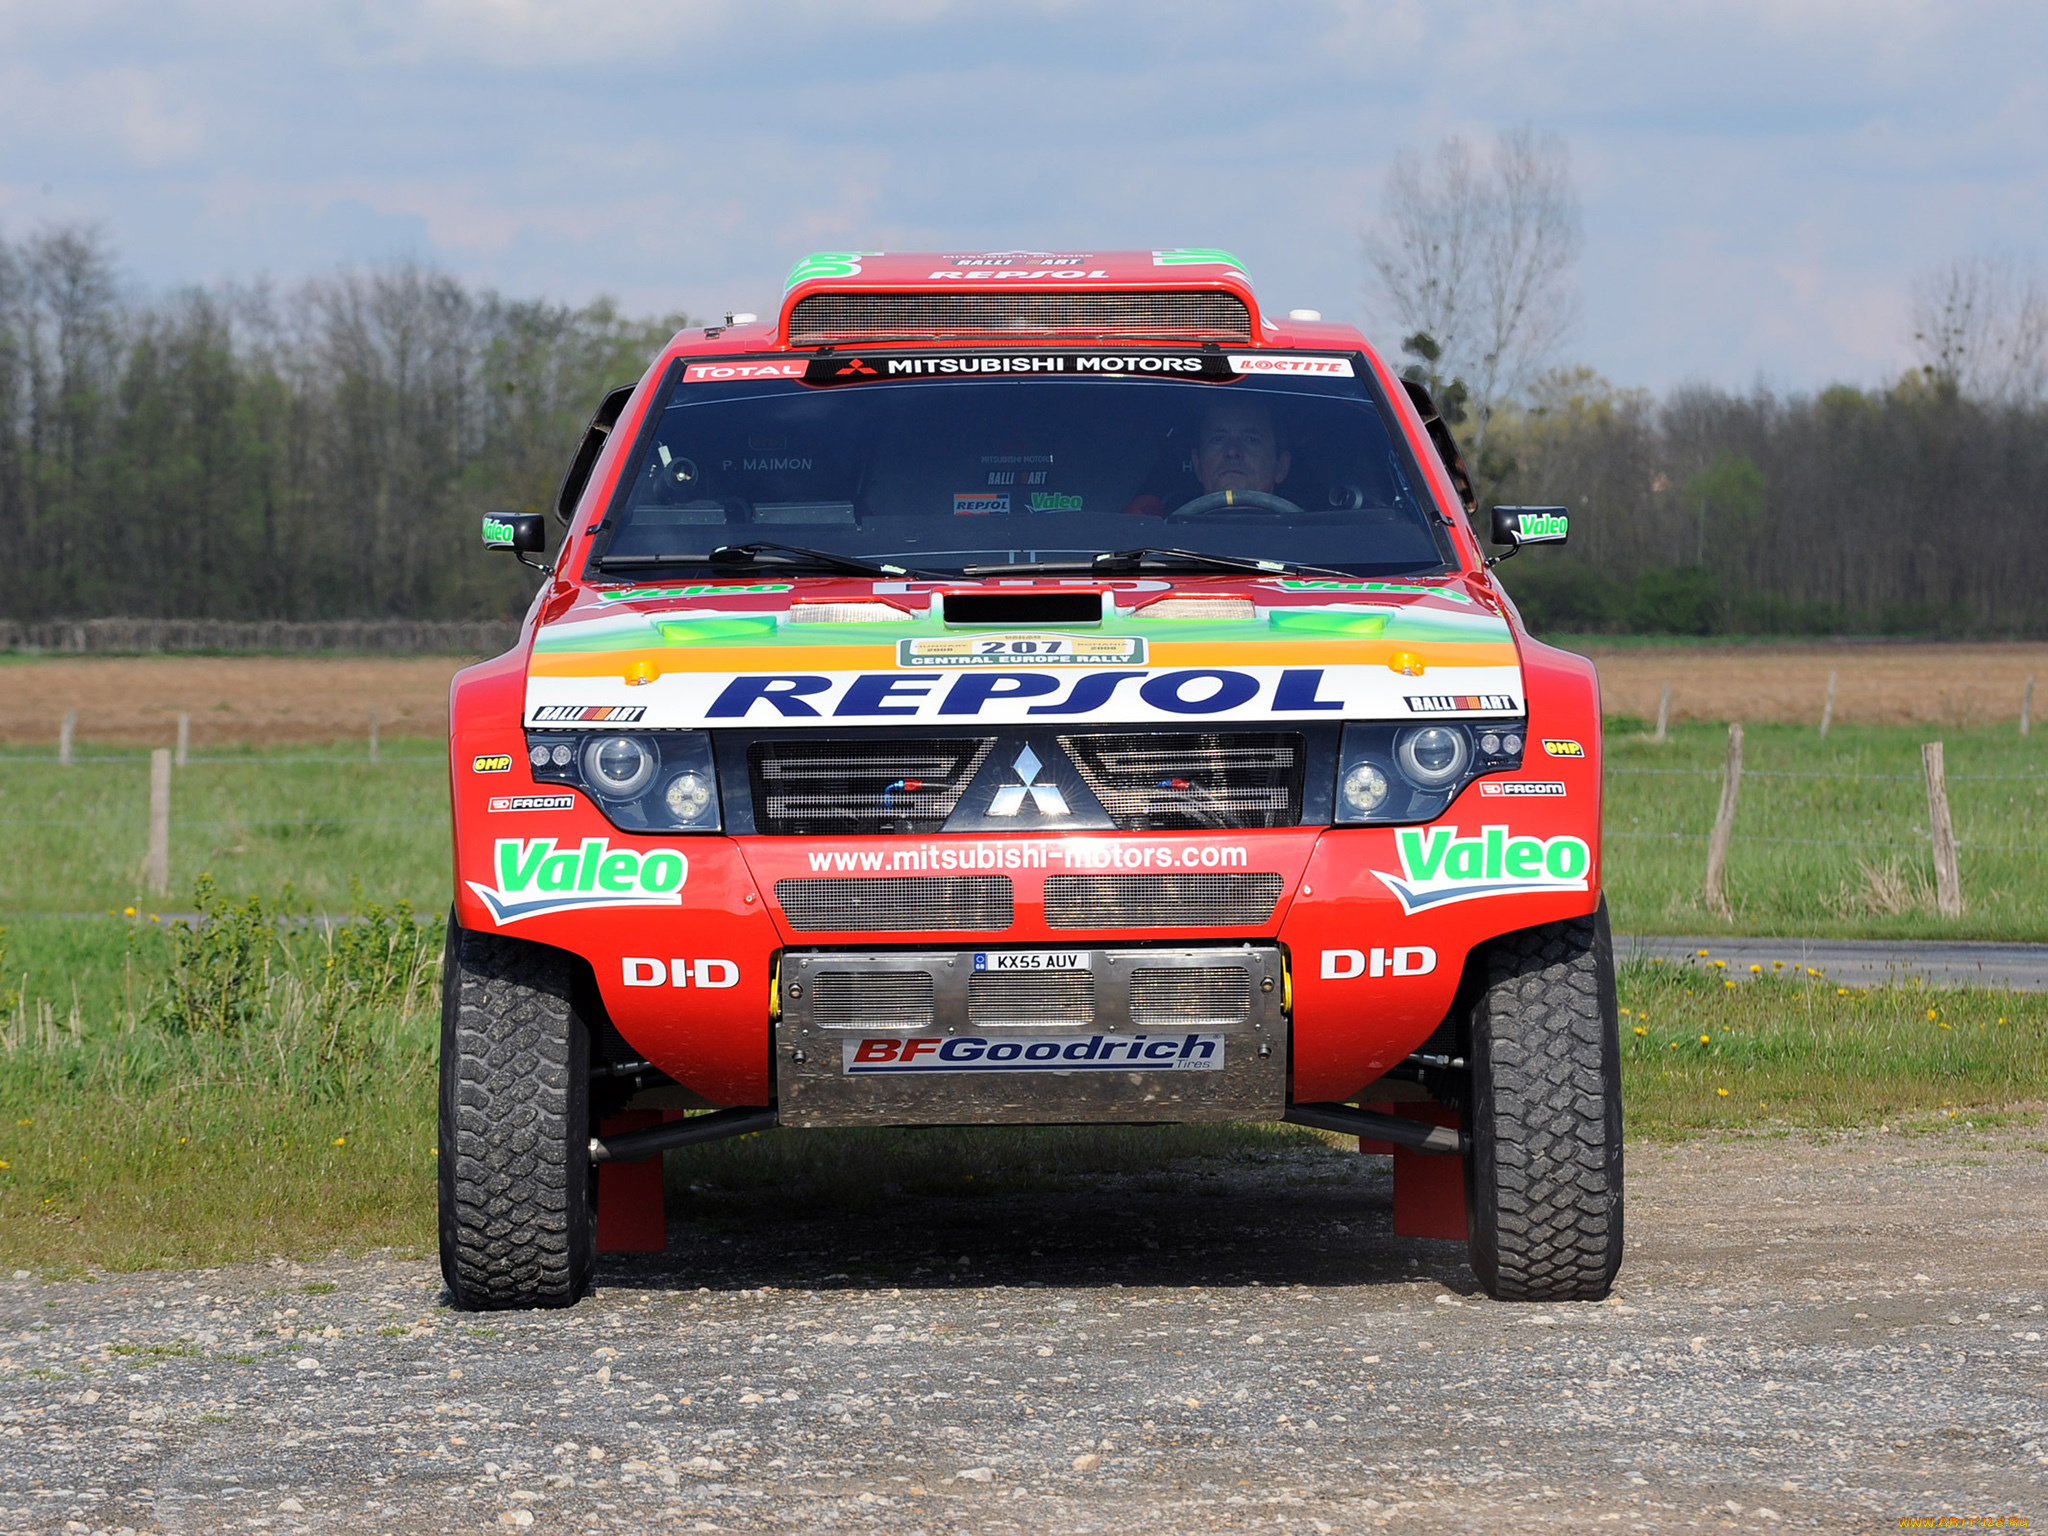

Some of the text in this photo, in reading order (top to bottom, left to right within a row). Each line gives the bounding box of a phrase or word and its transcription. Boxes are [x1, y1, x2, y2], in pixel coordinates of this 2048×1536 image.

[928, 270, 1109, 280] REPSOL
[690, 365, 801, 378] TOTAL
[889, 356, 1203, 374] MITSUBISHI MOTORS
[1240, 360, 1342, 373] LOCTITE
[722, 458, 812, 471] P. MAIMON
[956, 501, 1008, 510] REPSOL
[1031, 493, 1083, 510] Valeo
[482, 517, 514, 543] Valeo
[1518, 514, 1569, 537] Valeo
[598, 583, 796, 602] Valeo
[1273, 579, 1473, 606] Valeo
[981, 641, 1062, 654] 207
[911, 655, 1131, 665] CENTRAL EUROPE RALLY
[704, 668, 1345, 719] REPSOL
[1505, 785, 1563, 793] FACOM
[512, 797, 571, 809] FACOM
[808, 844, 1248, 871] www.mitsubishi-motors.com
[1398, 828, 1588, 882] Valeo
[496, 840, 686, 894] Valeo
[998, 955, 1077, 969] KX55 AUV
[853, 1034, 1216, 1063] BFGoodrich
[1176, 1059, 1211, 1069] Tires
